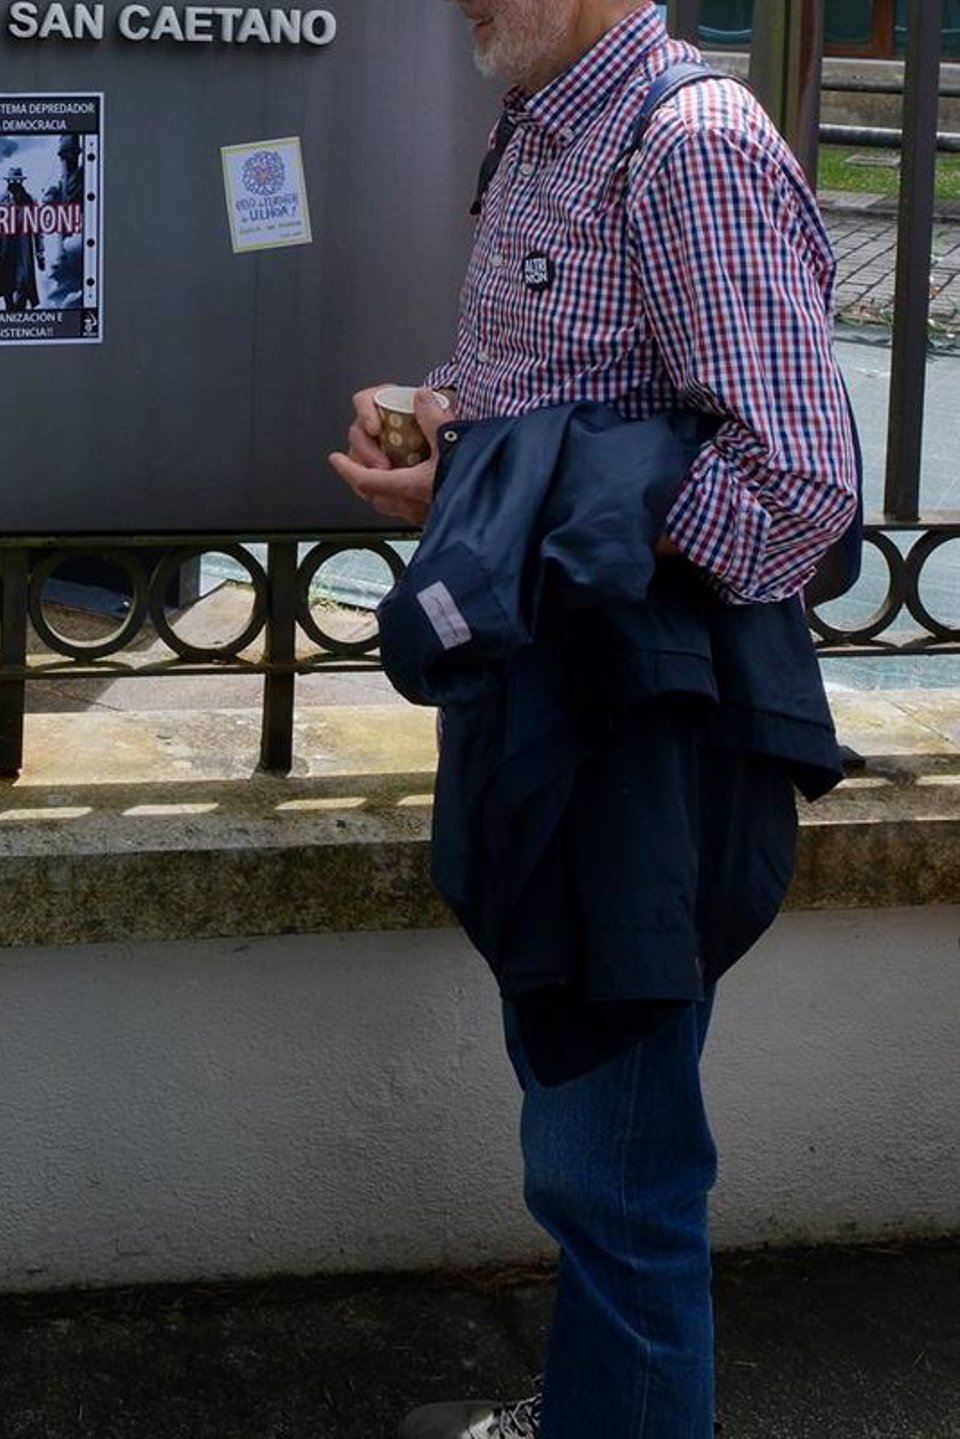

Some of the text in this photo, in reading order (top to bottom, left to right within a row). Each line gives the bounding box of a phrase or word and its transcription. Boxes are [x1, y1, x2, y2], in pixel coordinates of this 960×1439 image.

[8, 1, 337, 46] SAN CAETANO
[29, 102, 95, 114] DEPREDADOR
[2, 119, 67, 131] DEMOCRACIA
[23, 204, 81, 233] NON!
[56, 311, 63, 323] E
